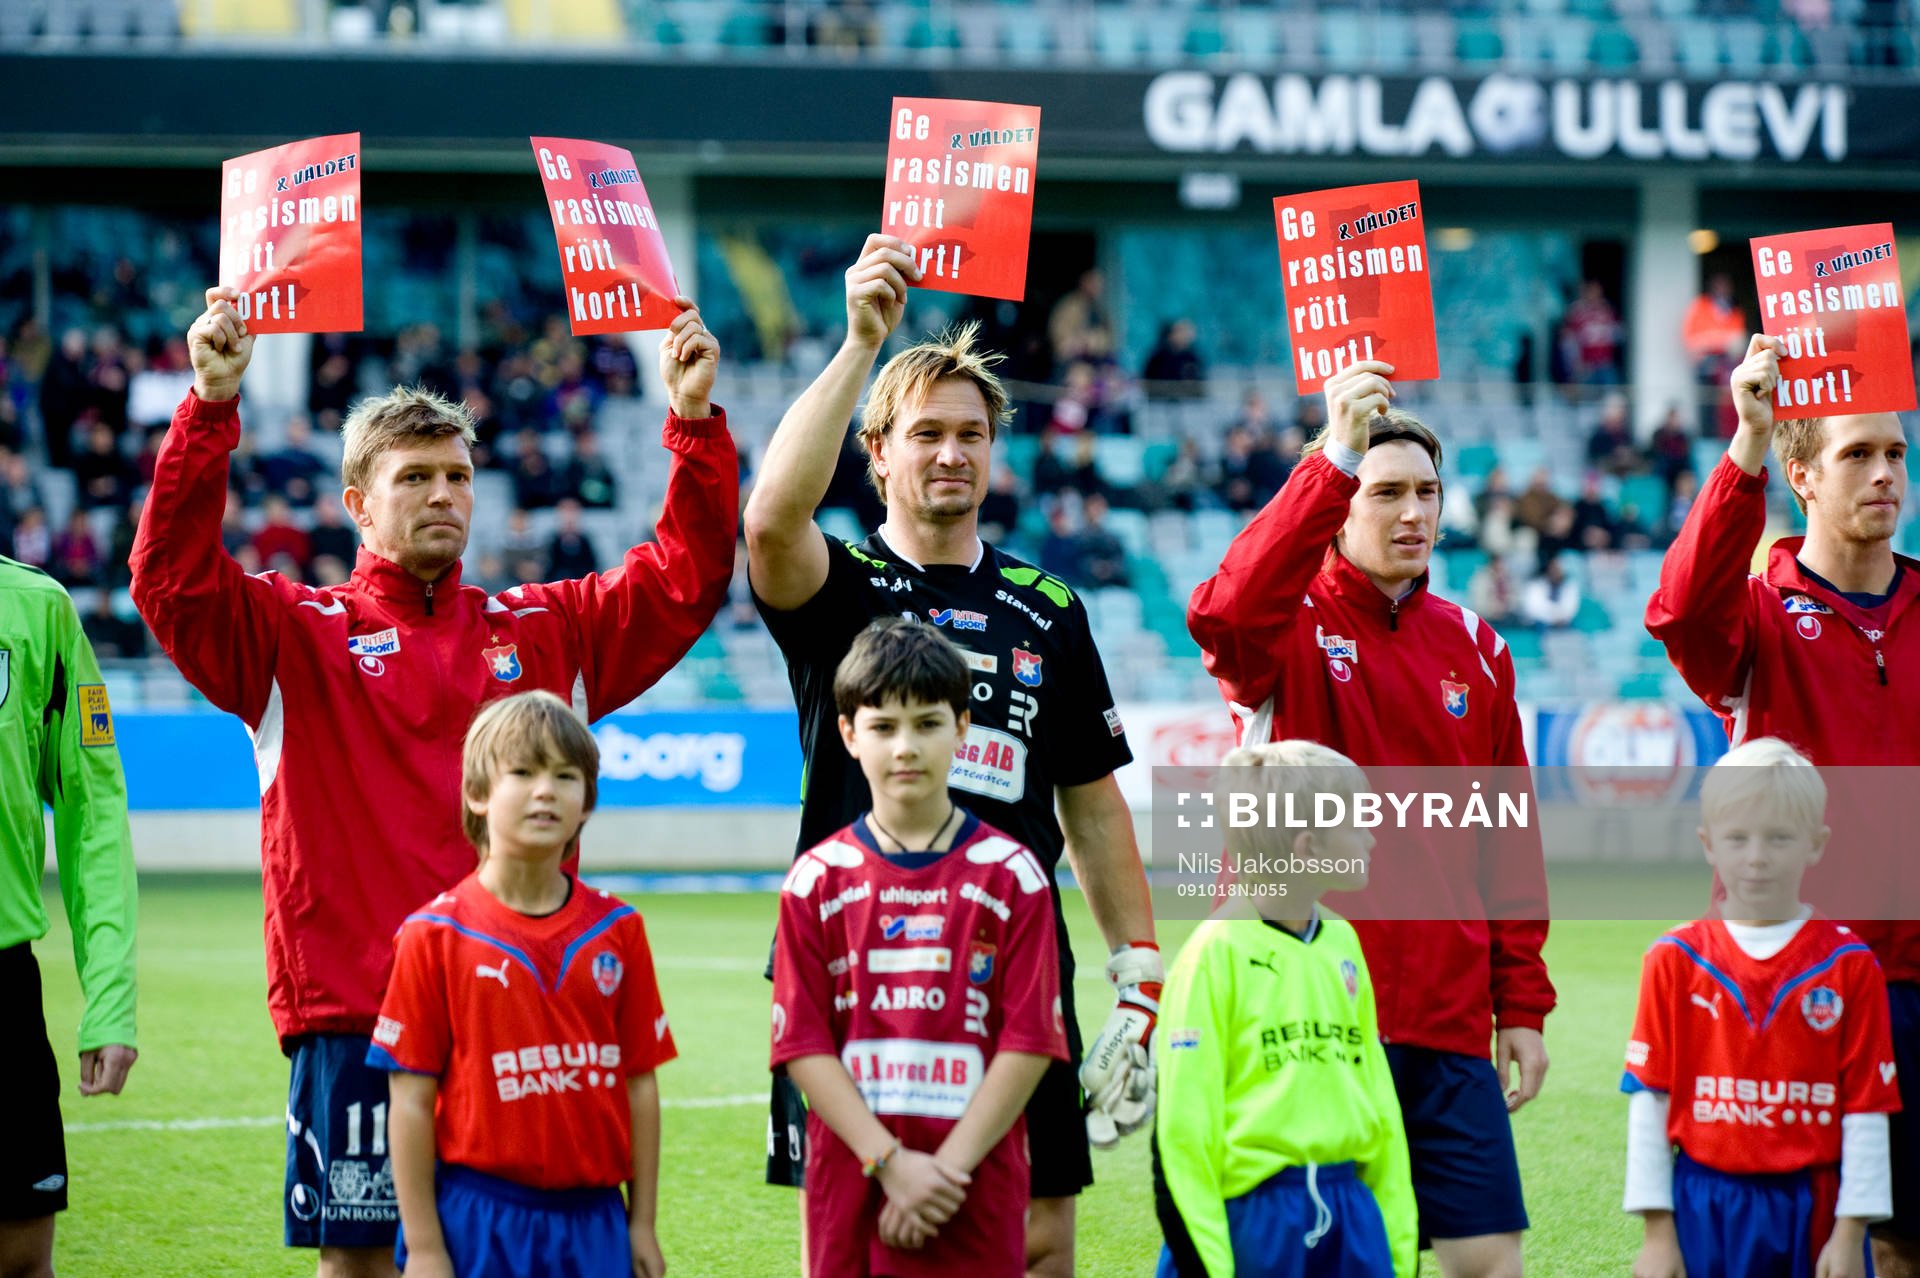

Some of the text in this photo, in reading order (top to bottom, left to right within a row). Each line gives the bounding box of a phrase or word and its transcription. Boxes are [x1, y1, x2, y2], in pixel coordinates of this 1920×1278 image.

[895, 107, 930, 141] Ge
[1143, 70, 1850, 163] GAMLA ULLEVI
[951, 127, 1036, 150] & VÅLDET
[276, 153, 357, 192] & VÅLDET
[539, 147, 572, 181] Ge
[589, 168, 641, 189] & VÅLDET
[892, 154, 1030, 194] rasismen
[228, 167, 258, 200] Ge
[226, 193, 356, 242] rasismen
[553, 193, 658, 232] rasismen
[888, 195, 945, 229] rött
[1281, 206, 1316, 241] Ge
[1338, 201, 1418, 241] & VÅLDET
[564, 238, 616, 273] rött
[1288, 244, 1423, 287] rasismen
[1758, 246, 1793, 277] Ge
[1815, 242, 1893, 278] & VÅLDET
[231, 284, 296, 321] ort!
[571, 282, 642, 322] kort!
[1293, 293, 1350, 333] rött
[1765, 281, 1899, 319] rasismen
[1776, 369, 1853, 408] kort!
[953, 608, 987, 622] INTER
[953, 619, 987, 633] SPORT
[994, 589, 1053, 632] Stavdal
[360, 631, 394, 646] INTER
[362, 641, 395, 654] SPORT
[982, 740, 1015, 772] AB
[879, 885, 948, 907] uhlsport
[1098, 1016, 1137, 1071] uhlsport
[496, 1069, 583, 1103] BANK
[931, 1056, 968, 1086] AB
[1694, 1075, 1837, 1106] RESURS
[1692, 1100, 1776, 1128] BANK
